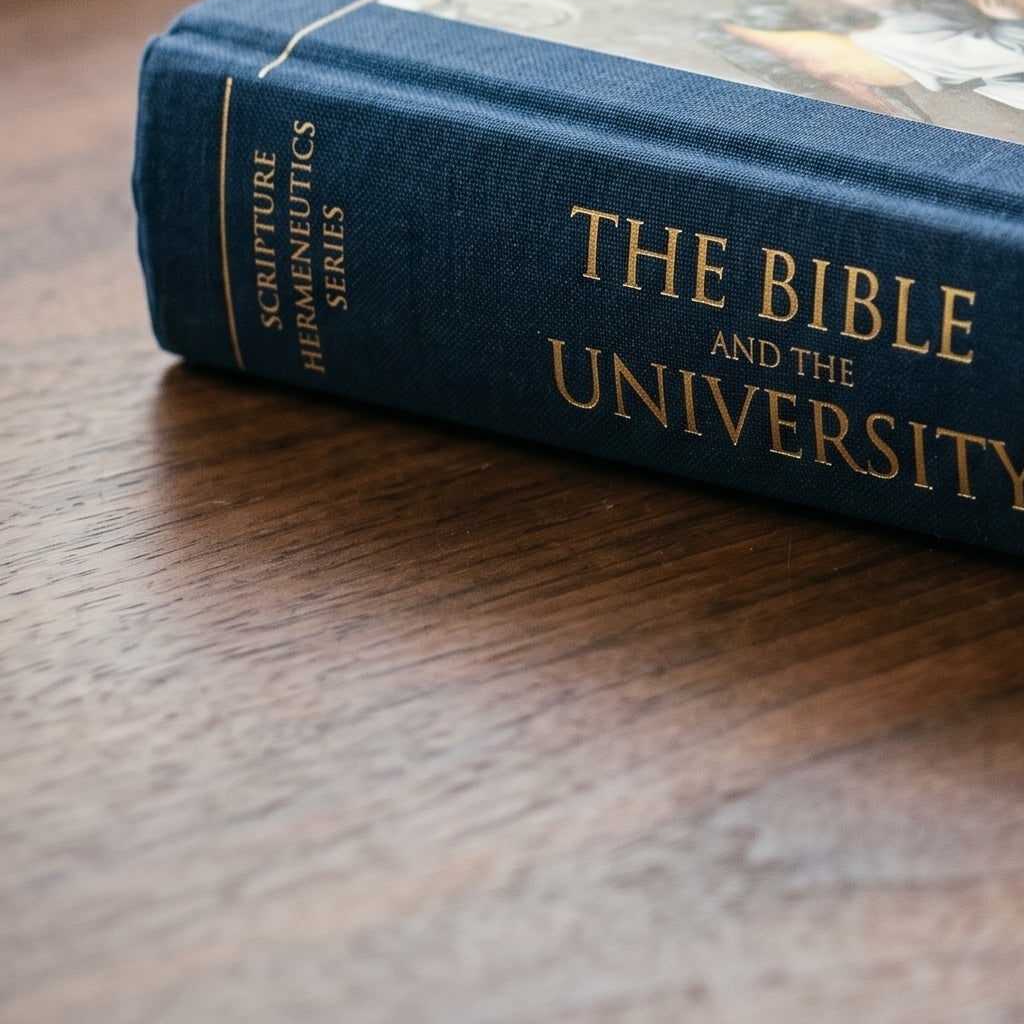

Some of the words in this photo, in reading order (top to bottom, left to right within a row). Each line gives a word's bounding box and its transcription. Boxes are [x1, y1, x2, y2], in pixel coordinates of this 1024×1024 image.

[254, 149, 283, 331] SCRIPTURE
[290, 120, 326, 373] HERMENEUTICS
[323, 205, 347, 310] SERIES
[570, 205, 728, 308] THE
[758, 247, 976, 364] BIBLE
[711, 330, 781, 369] AND
[790, 346, 854, 387] THE
